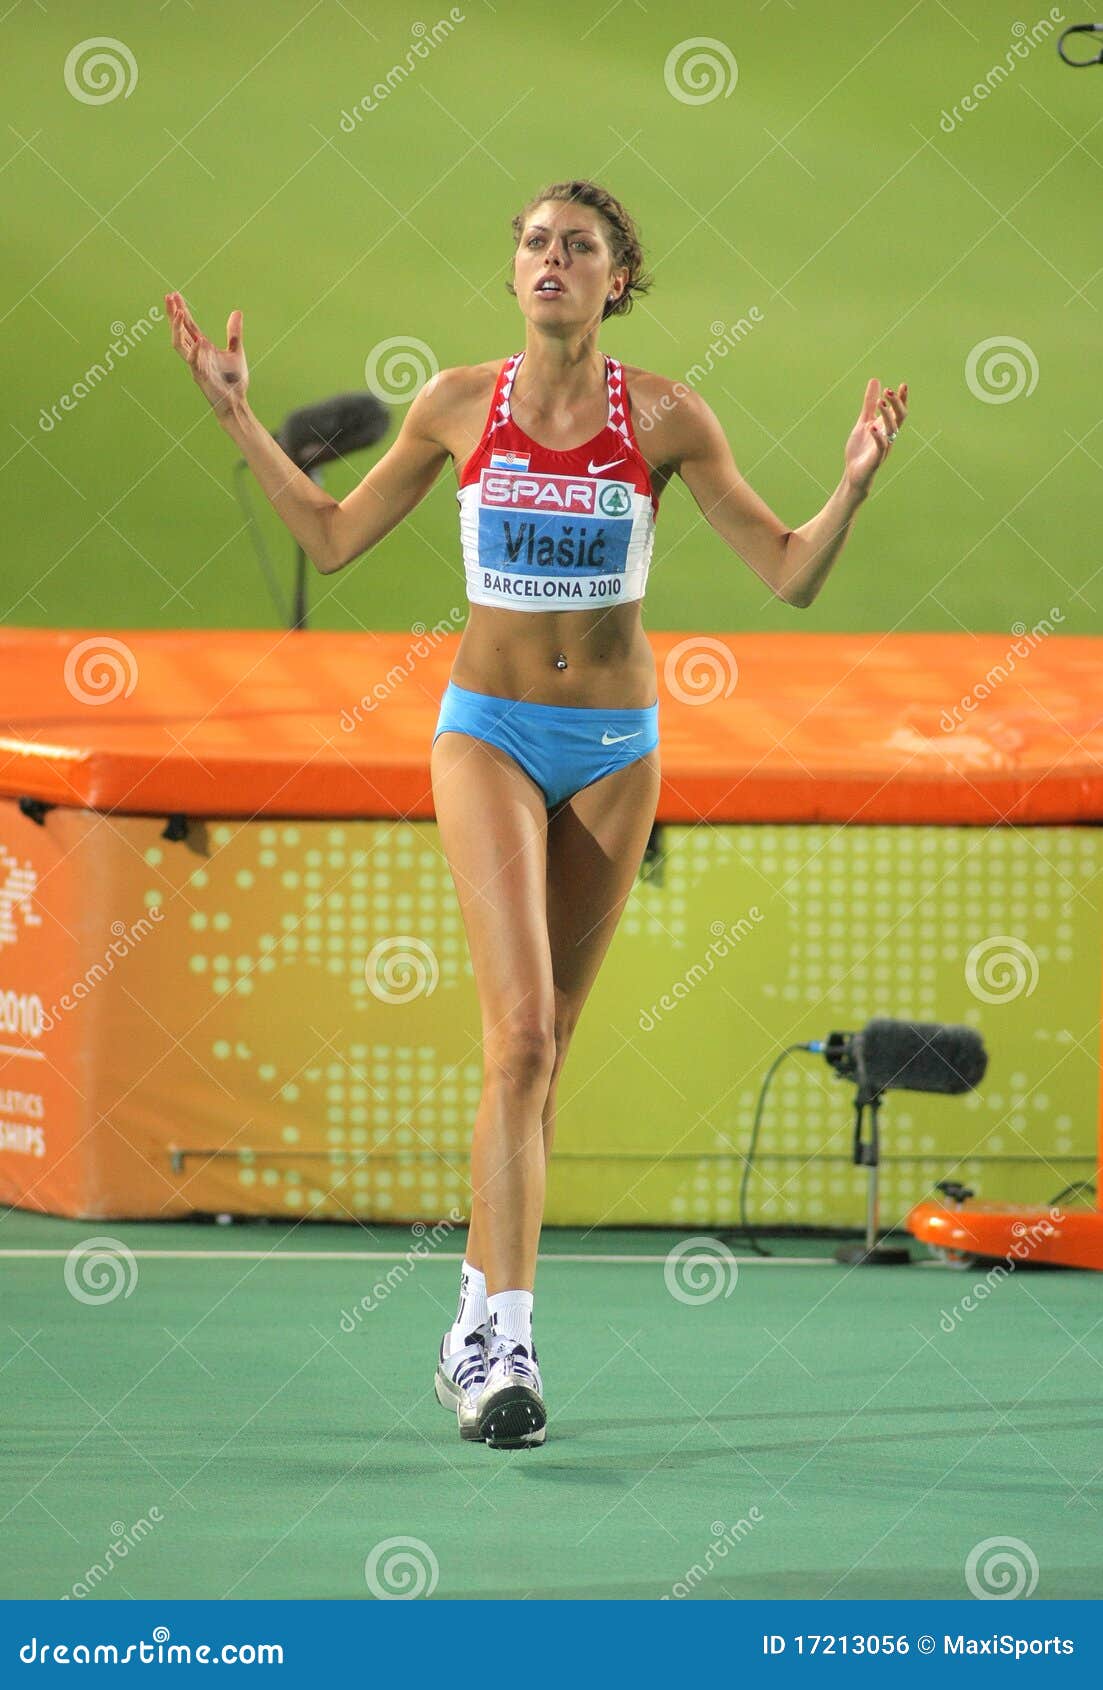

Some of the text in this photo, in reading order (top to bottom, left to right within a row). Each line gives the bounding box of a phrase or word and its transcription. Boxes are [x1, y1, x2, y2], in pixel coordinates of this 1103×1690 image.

[485, 478, 593, 509] SPAR
[503, 520, 606, 567] Vlašić
[484, 573, 621, 597] BARCELONA 2010
